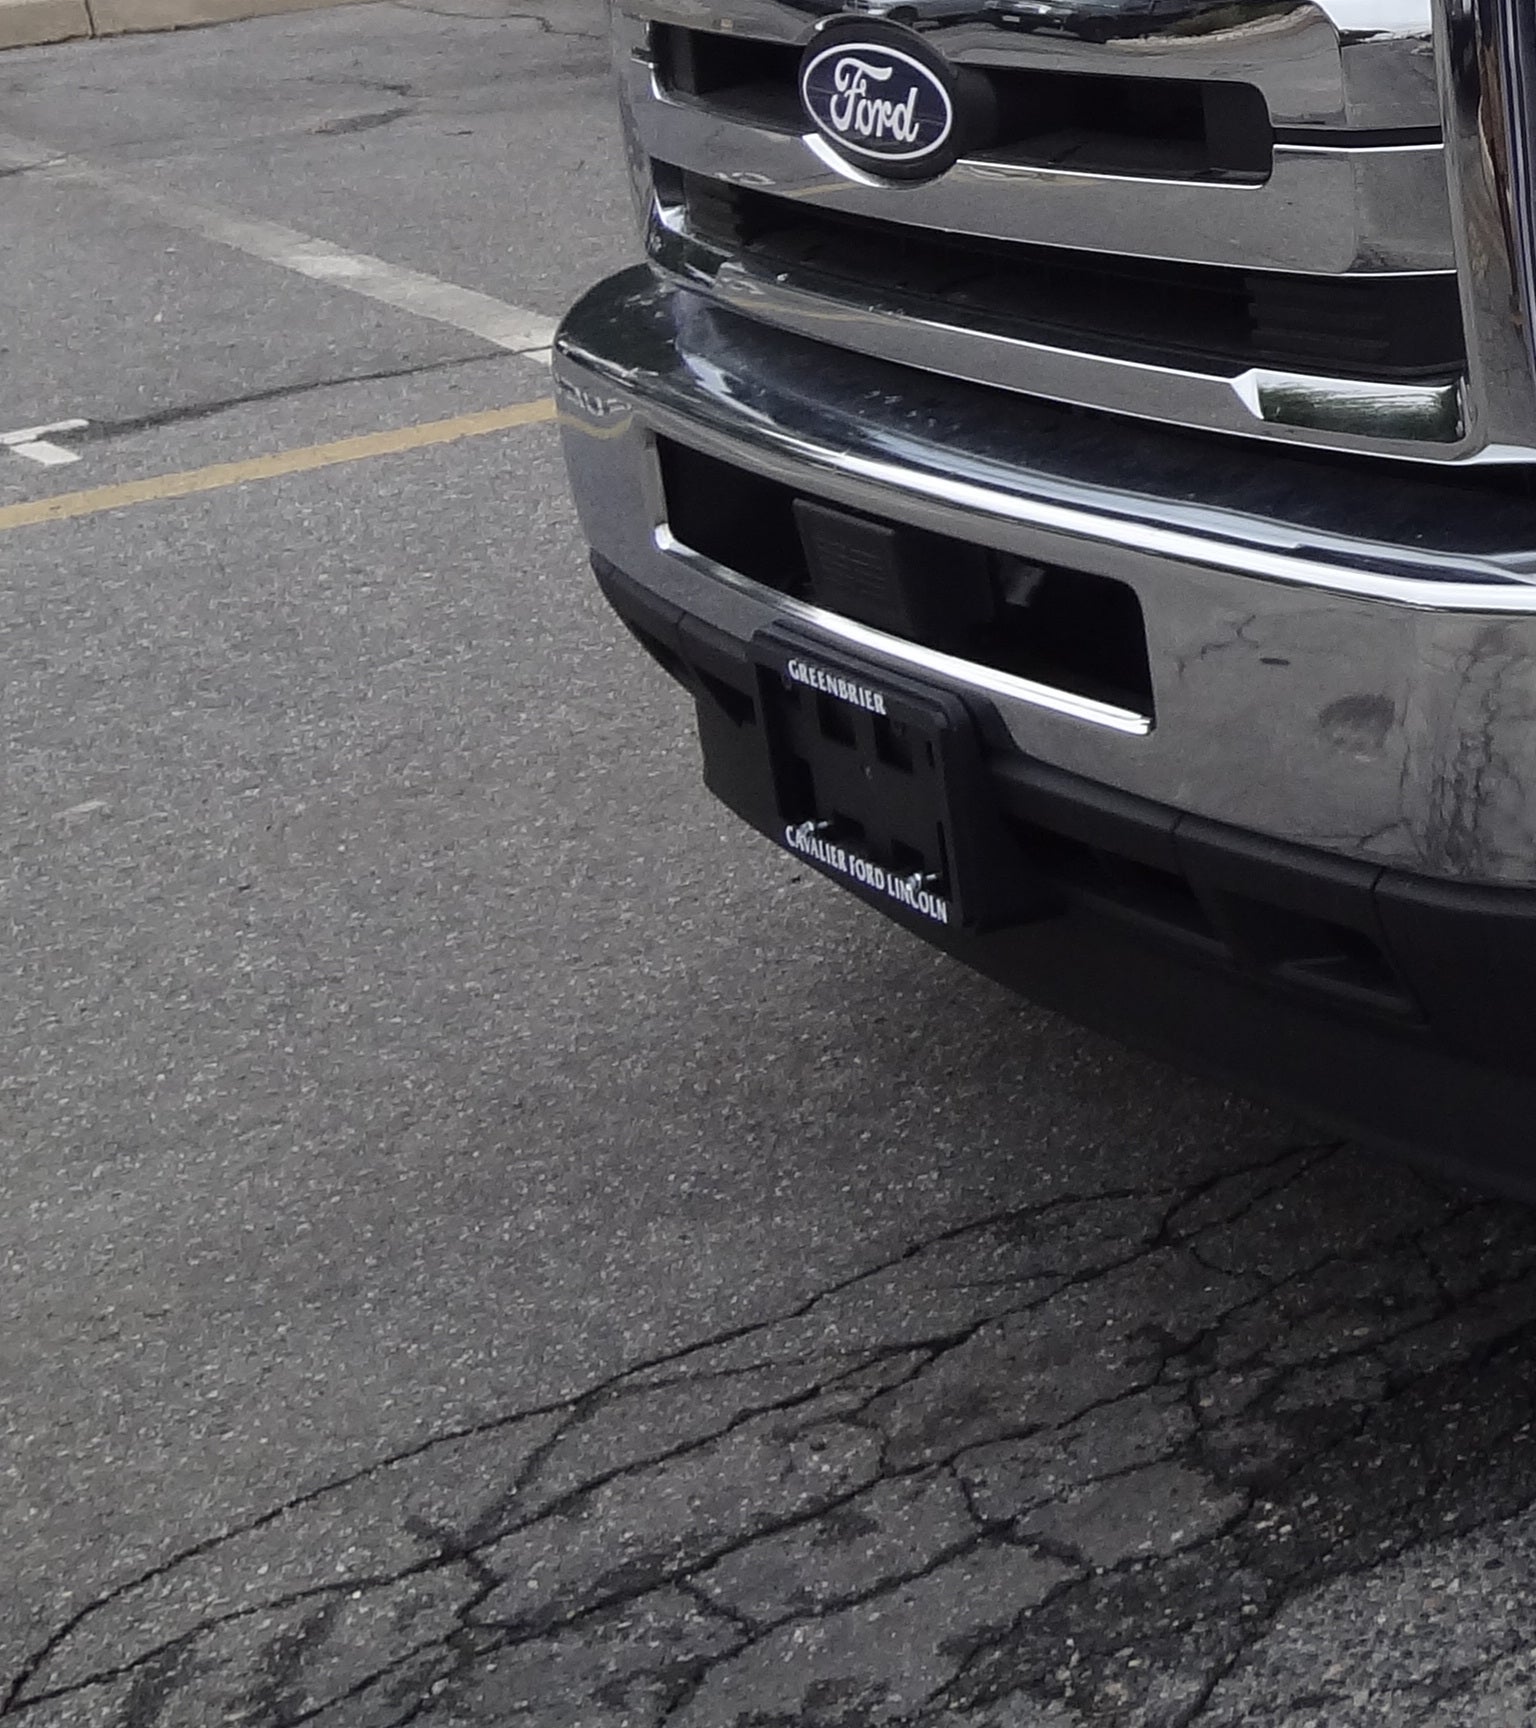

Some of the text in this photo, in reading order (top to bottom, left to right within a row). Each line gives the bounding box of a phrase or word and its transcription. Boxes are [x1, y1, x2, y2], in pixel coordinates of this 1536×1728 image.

[830, 57, 919, 142] Ford
[788, 658, 887, 715] GREENBRIER
[785, 825, 948, 924] CAVALIER FORD LINCOLN
